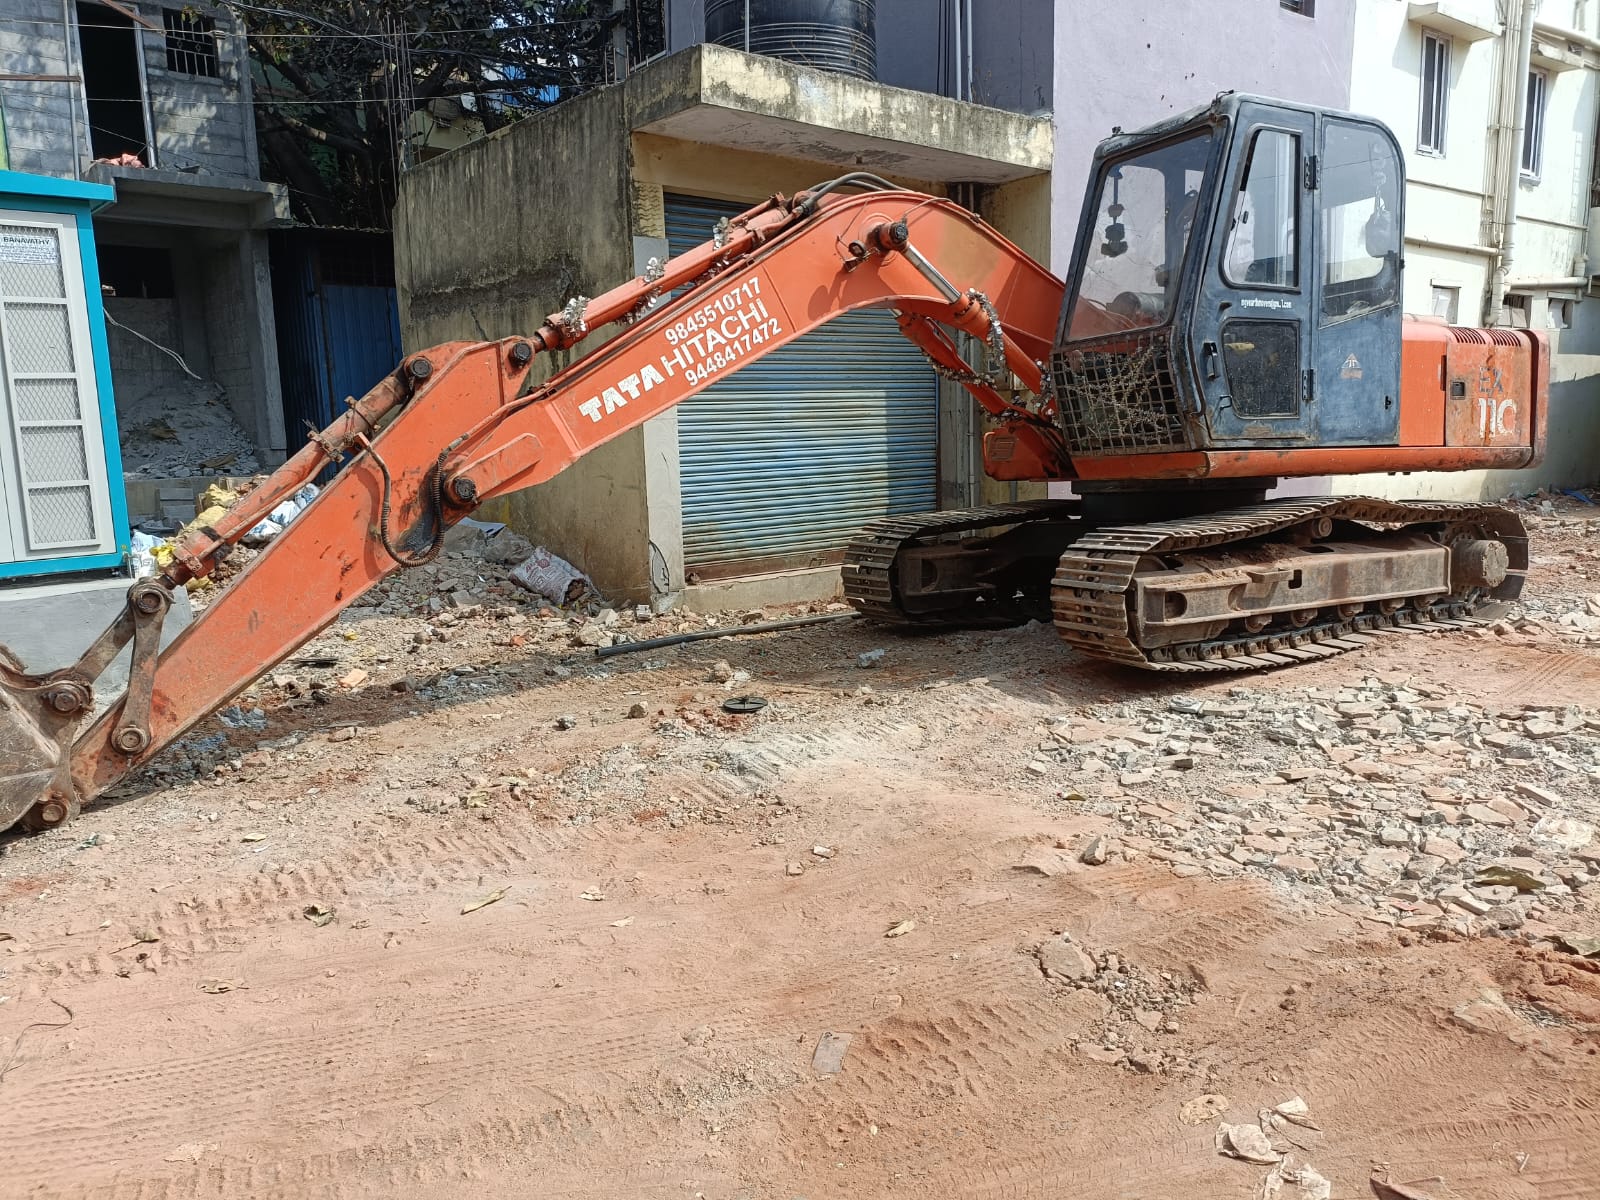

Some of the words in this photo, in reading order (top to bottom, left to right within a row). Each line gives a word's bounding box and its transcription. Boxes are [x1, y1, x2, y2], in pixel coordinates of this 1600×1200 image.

[665, 276, 761, 345] 9845510717
[578, 364, 665, 423] TATA
[661, 298, 769, 377] HITACHI
[684, 317, 782, 387] 9448417472
